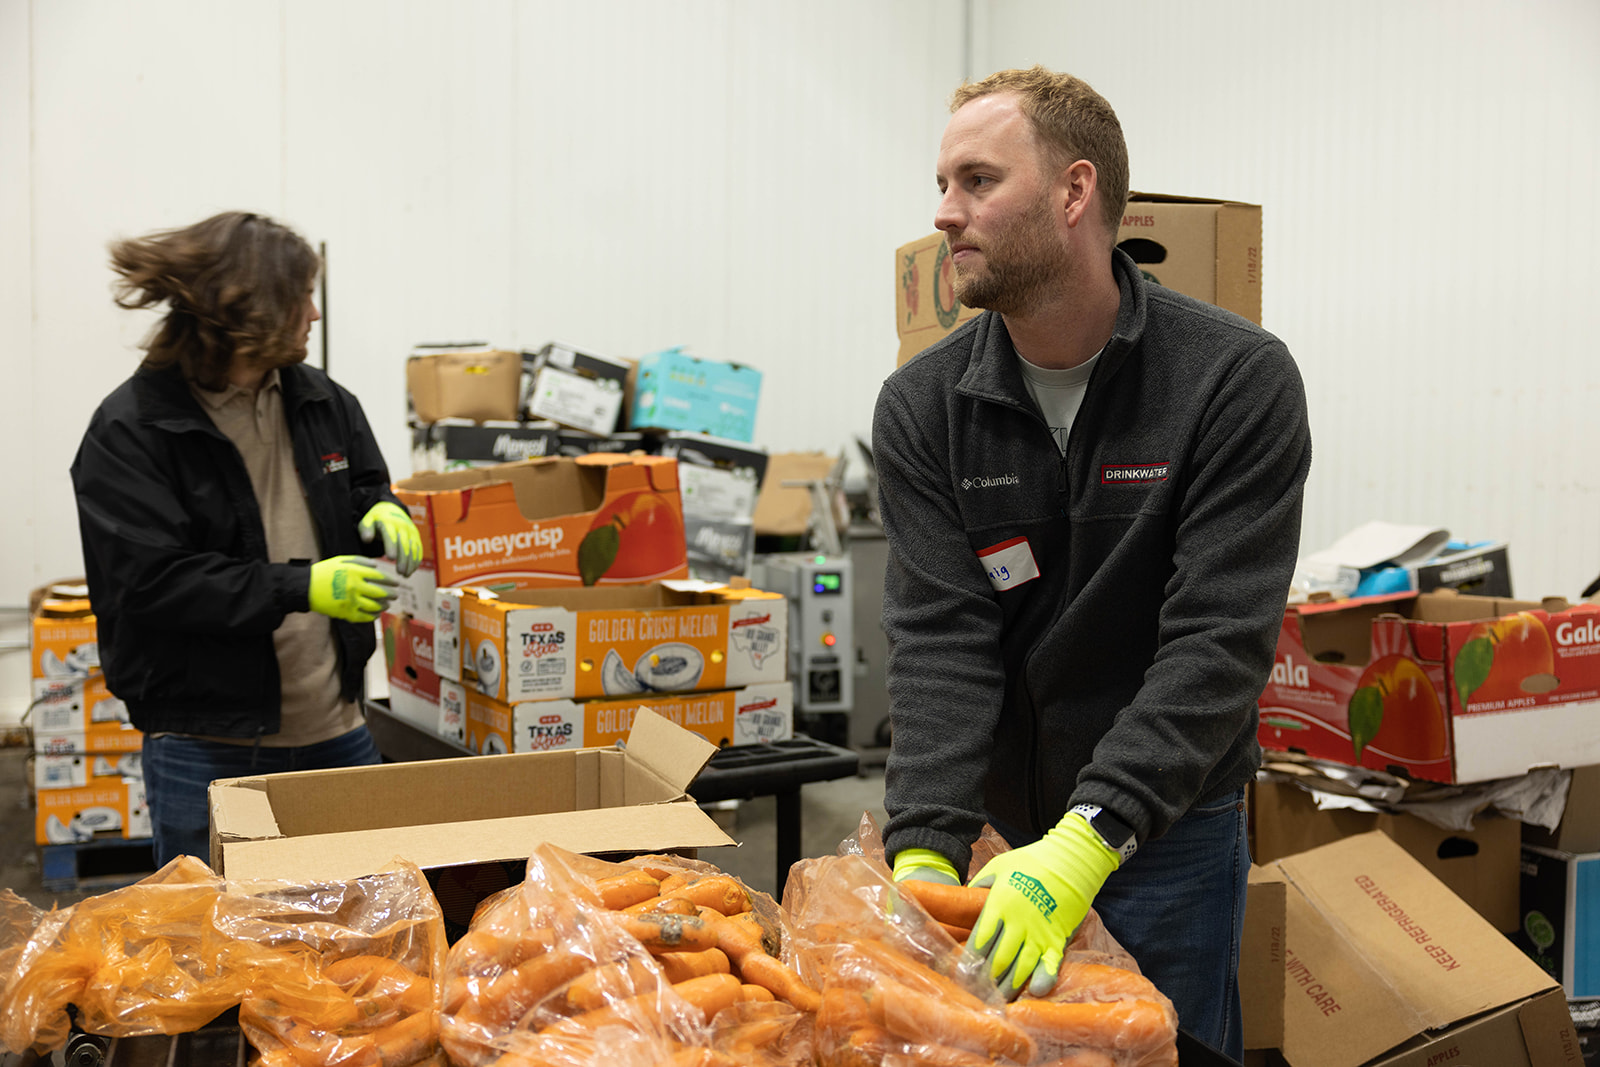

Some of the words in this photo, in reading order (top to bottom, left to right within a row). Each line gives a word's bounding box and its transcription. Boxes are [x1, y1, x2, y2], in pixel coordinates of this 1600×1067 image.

[1122, 215, 1154, 227] APPLES
[1248, 247, 1257, 284] 1/18/22
[972, 473, 1019, 489] Columbia
[1105, 467, 1168, 480] DRINKWATER
[443, 523, 564, 560] Honeycrisp
[988, 565, 1010, 581] aig
[520, 631, 565, 646] TEXAS
[589, 617, 635, 643] GOLDEN
[639, 616, 675, 641] CRUSH
[679, 614, 718, 638] MELON
[1269, 654, 1309, 688] ala
[596, 708, 638, 734] GOLDE
[685, 700, 724, 726] MELON
[1467, 700, 1505, 713] PREMIUM
[1507, 696, 1536, 708] APPLES
[528, 722, 573, 739] TEXAS
[1007, 878, 1052, 924] SOURCE
[1013, 872, 1056, 910] PROJECT
[1354, 874, 1433, 945] REFRIGERATED
[1271, 926, 1281, 963] 1/18/22
[1424, 944, 1461, 972] KEEP
[1286, 957, 1316, 987] WITH
[1306, 984, 1342, 1017] CARE
[1426, 1045, 1461, 1067] APPLES
